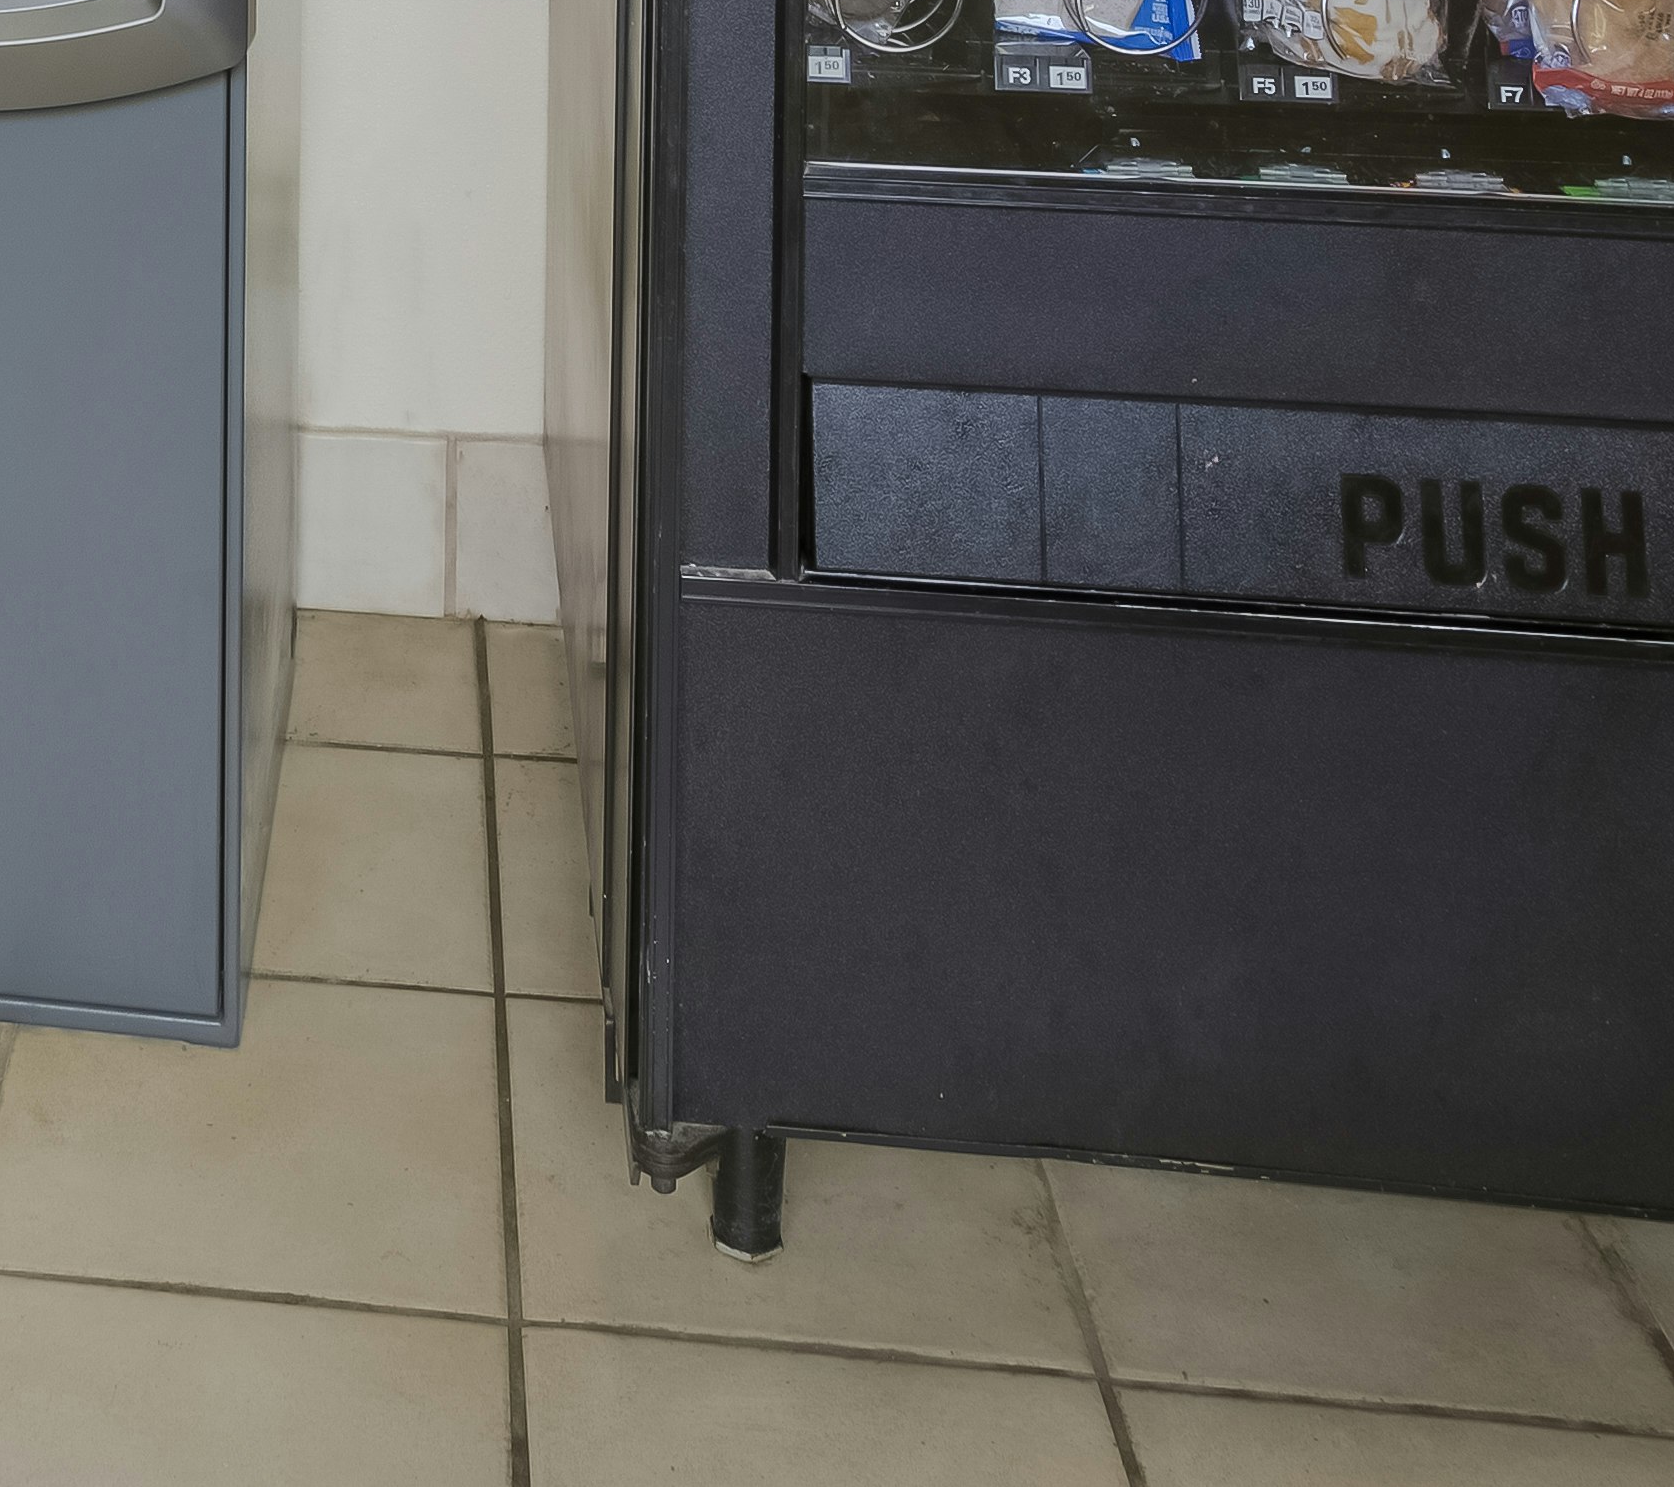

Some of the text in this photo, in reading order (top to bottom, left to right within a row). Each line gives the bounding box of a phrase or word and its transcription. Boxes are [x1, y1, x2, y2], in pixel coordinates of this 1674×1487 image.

[1252, 77, 1276, 95] F5
[1500, 87, 1524, 104] F7
[1339, 472, 1650, 599] PUSH
